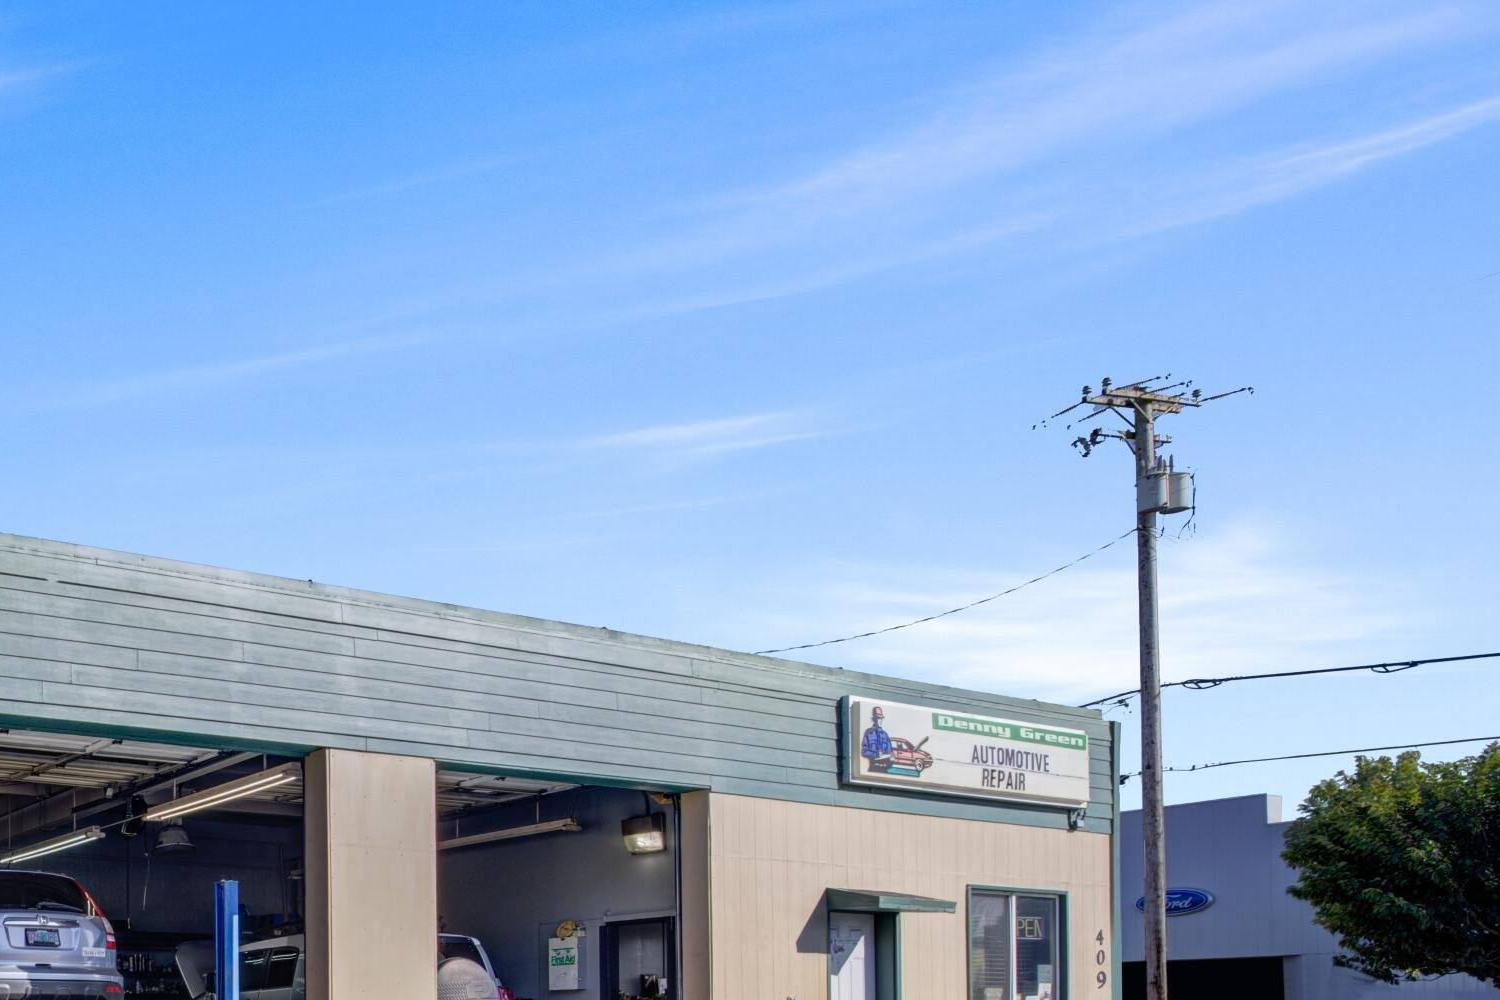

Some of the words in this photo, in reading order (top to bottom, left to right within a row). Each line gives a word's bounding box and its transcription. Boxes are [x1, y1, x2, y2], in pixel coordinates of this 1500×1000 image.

[938, 715, 1011, 738] Denny
[1020, 727, 1084, 747] Green
[972, 745, 1050, 773] AUTOMOTIVE
[982, 768, 1026, 791] REPAIR
[1016, 918, 1043, 938] PEN
[1096, 929, 1107, 990] 409
